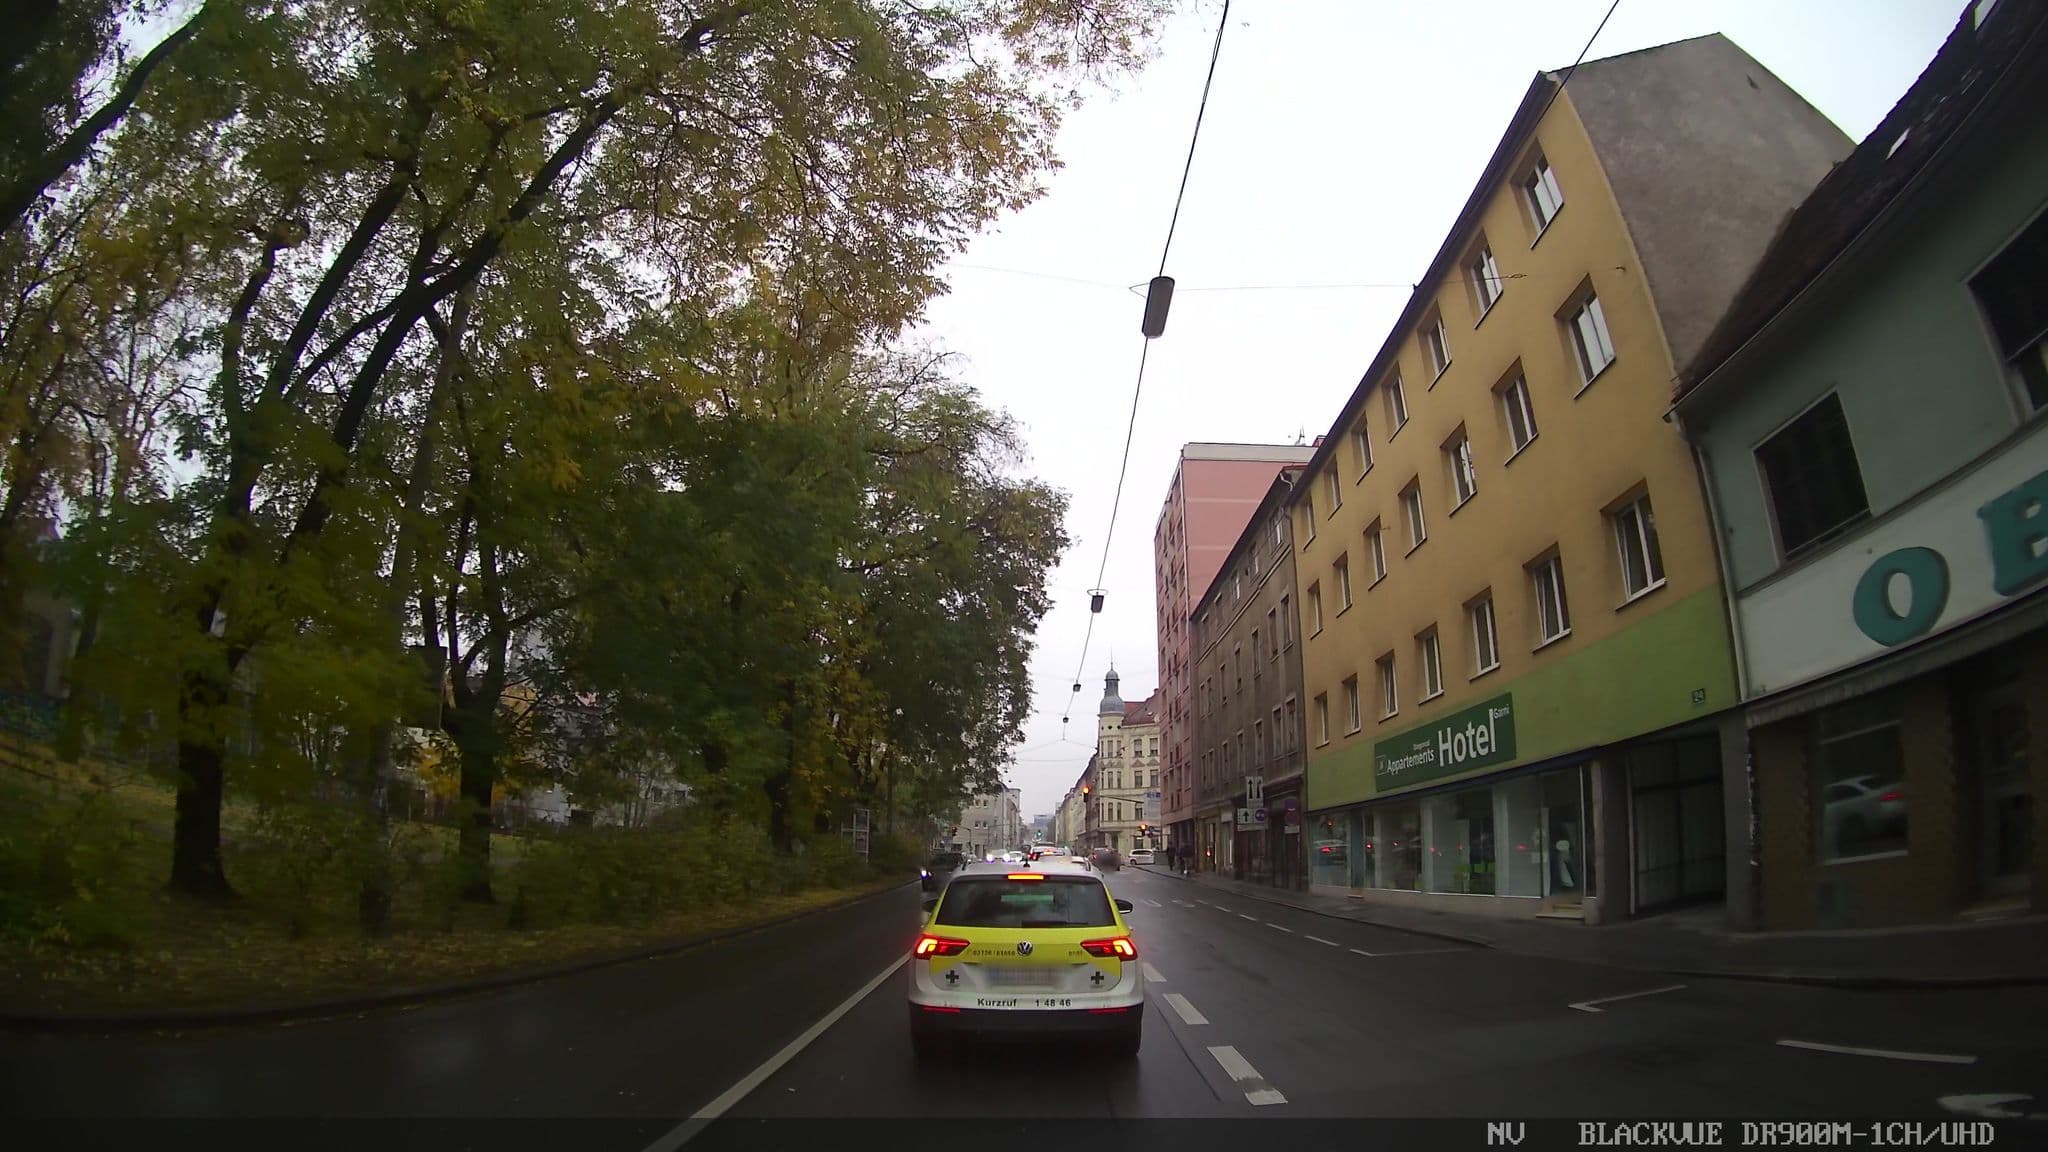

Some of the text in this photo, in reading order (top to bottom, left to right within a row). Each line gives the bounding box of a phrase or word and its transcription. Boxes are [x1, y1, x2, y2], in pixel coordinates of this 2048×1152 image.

[1387, 749, 1434, 775] Appartements
[1438, 708, 1497, 767] Hotel
[977, 998, 1071, 1007] Kurzruf 1 48 46
